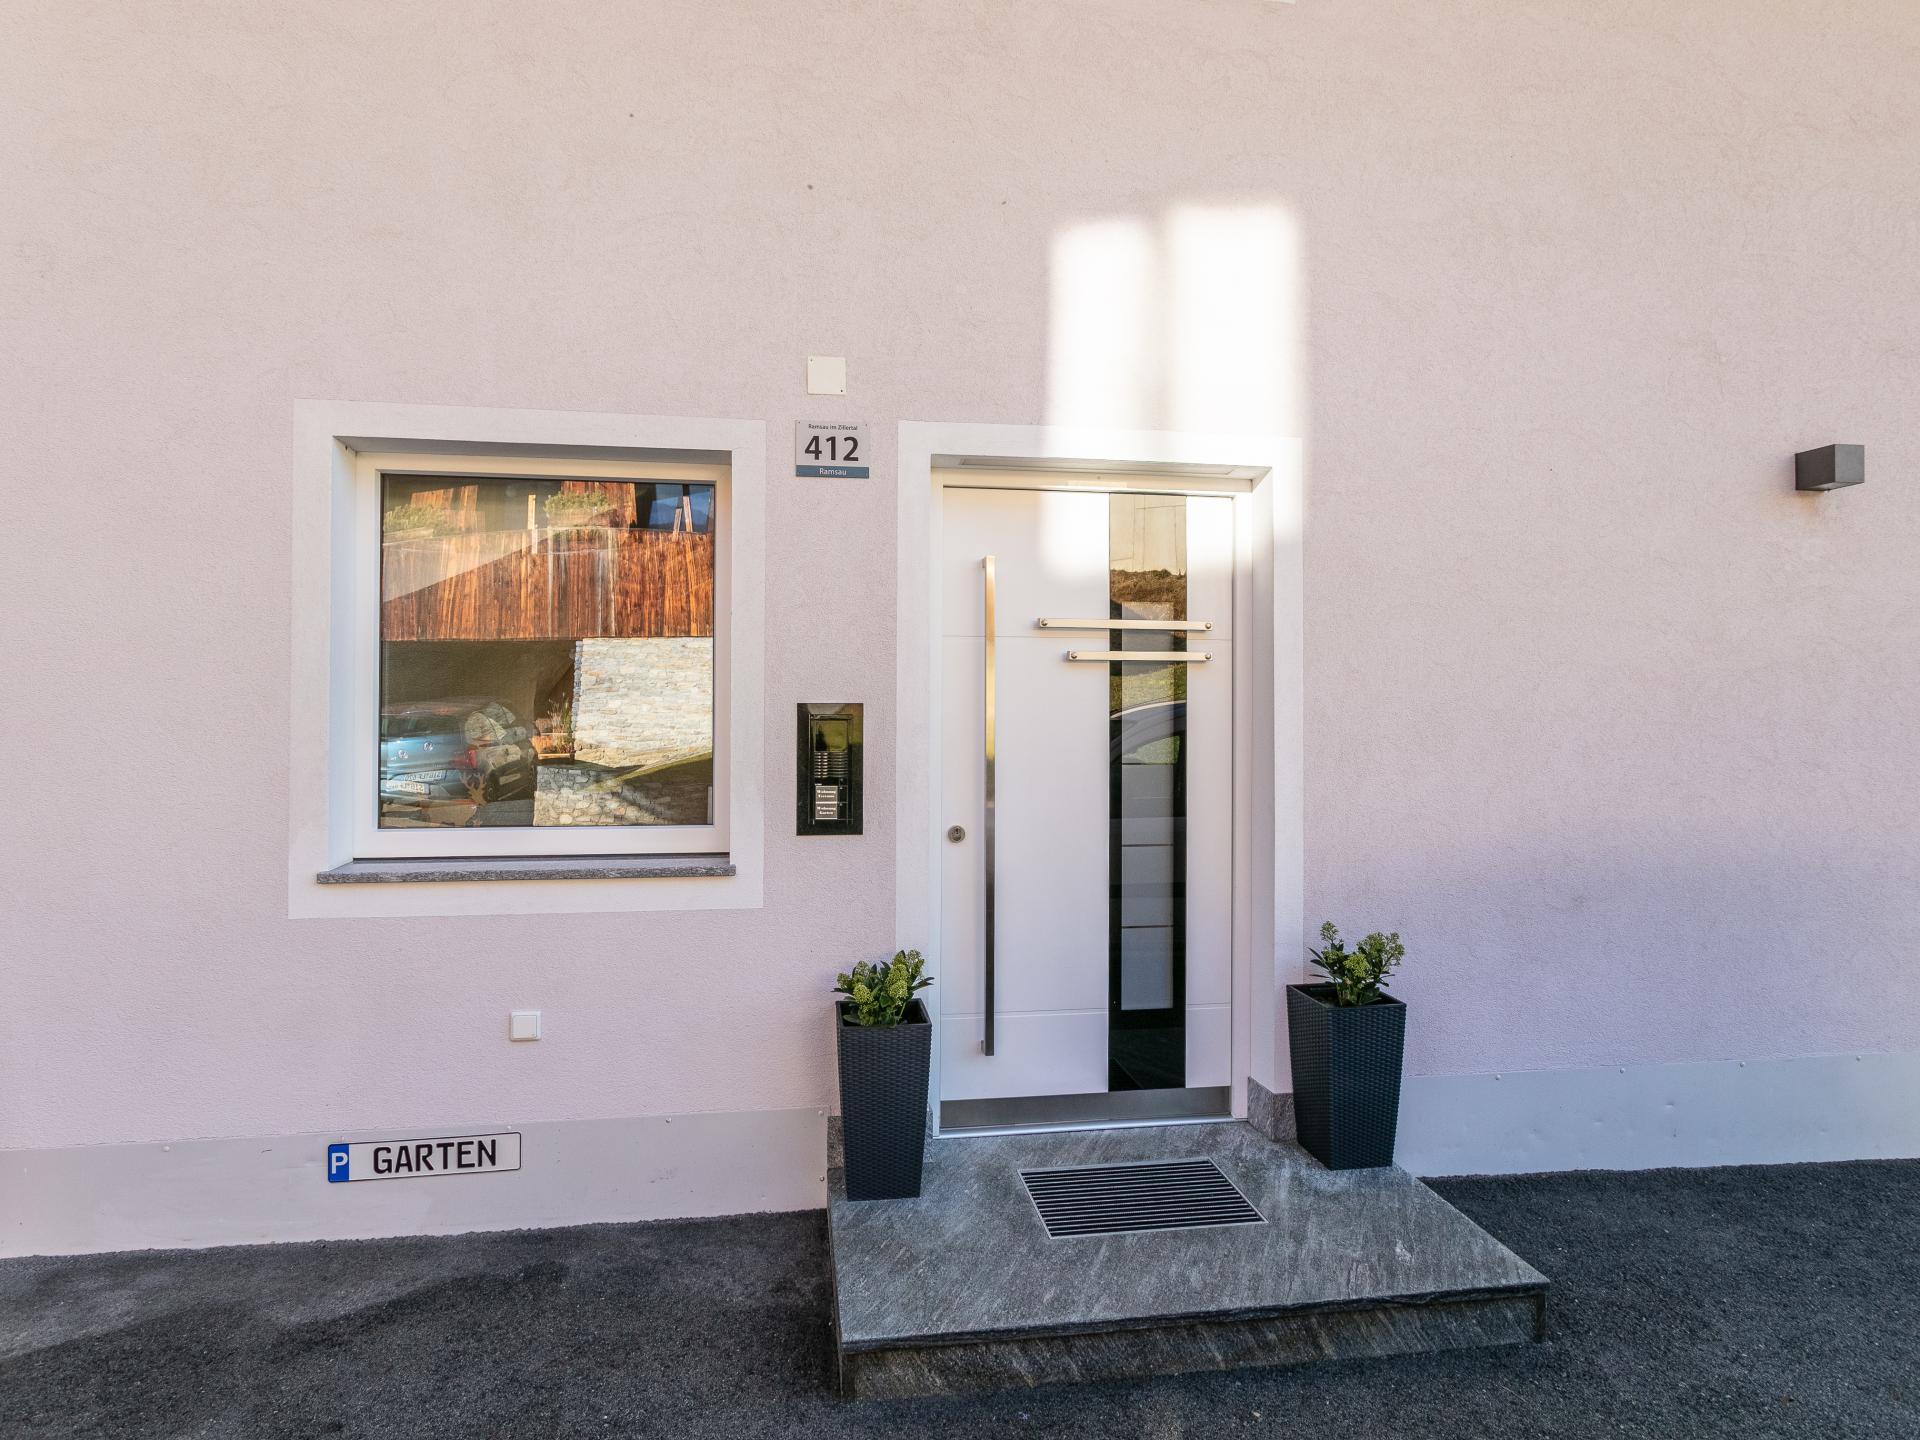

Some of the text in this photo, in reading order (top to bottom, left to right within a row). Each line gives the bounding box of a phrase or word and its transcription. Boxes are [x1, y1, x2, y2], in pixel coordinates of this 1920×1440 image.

[804, 435, 859, 461] 412
[819, 467, 848, 476] Ramsau
[331, 1139, 497, 1174] P GARTEN
